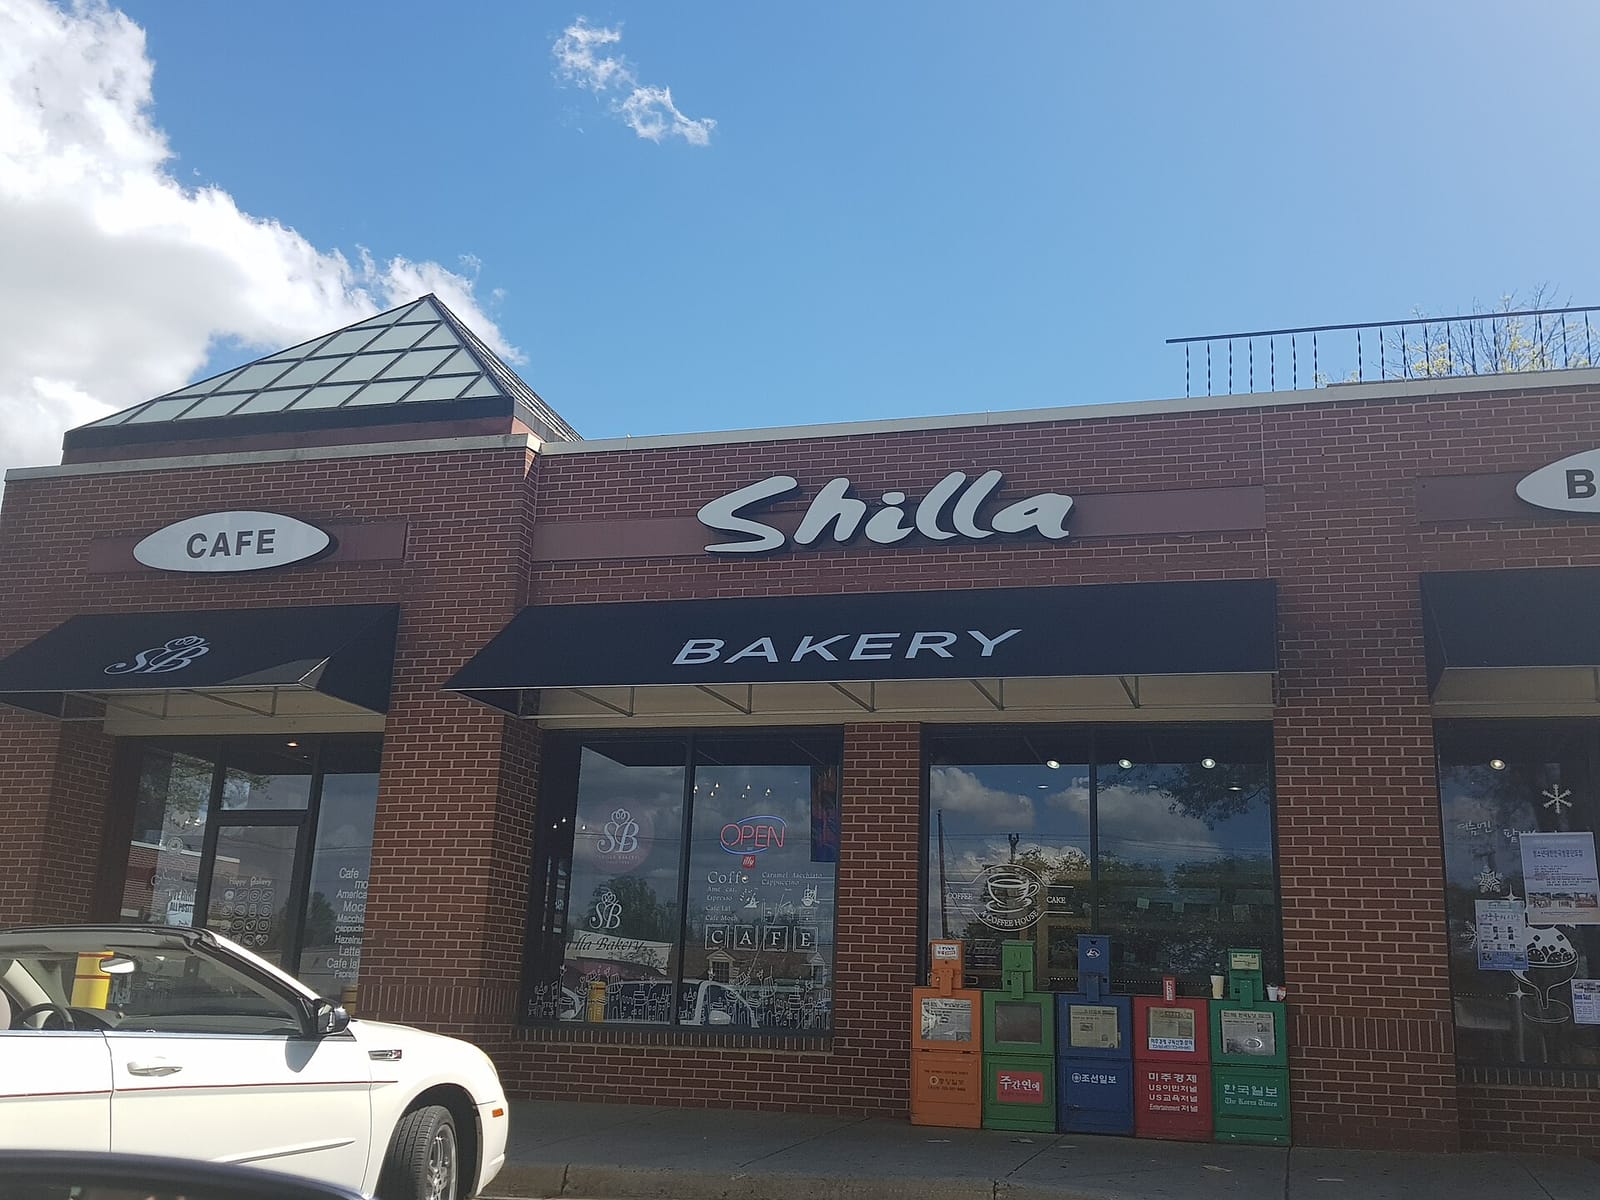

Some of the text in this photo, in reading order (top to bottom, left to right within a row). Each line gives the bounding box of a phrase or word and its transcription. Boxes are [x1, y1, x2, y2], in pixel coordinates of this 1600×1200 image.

[1566, 468, 1597, 500] B
[696, 470, 1075, 553] Shilla
[186, 528, 276, 559] CAFE
[672, 628, 1022, 666] BAKERY
[720, 823, 785, 848] OPEN
[339, 867, 359, 879] Cafe
[946, 892, 973, 900] COFFEE
[1046, 896, 1067, 904] CAKE
[1014, 909, 1039, 926] HOUSE
[326, 958, 347, 969] Cafe
[1081, 1074, 1116, 1084] 조선일보
[1148, 1072, 1197, 1083] 미주경제
[1223, 1084, 1277, 1097] 한국일보
